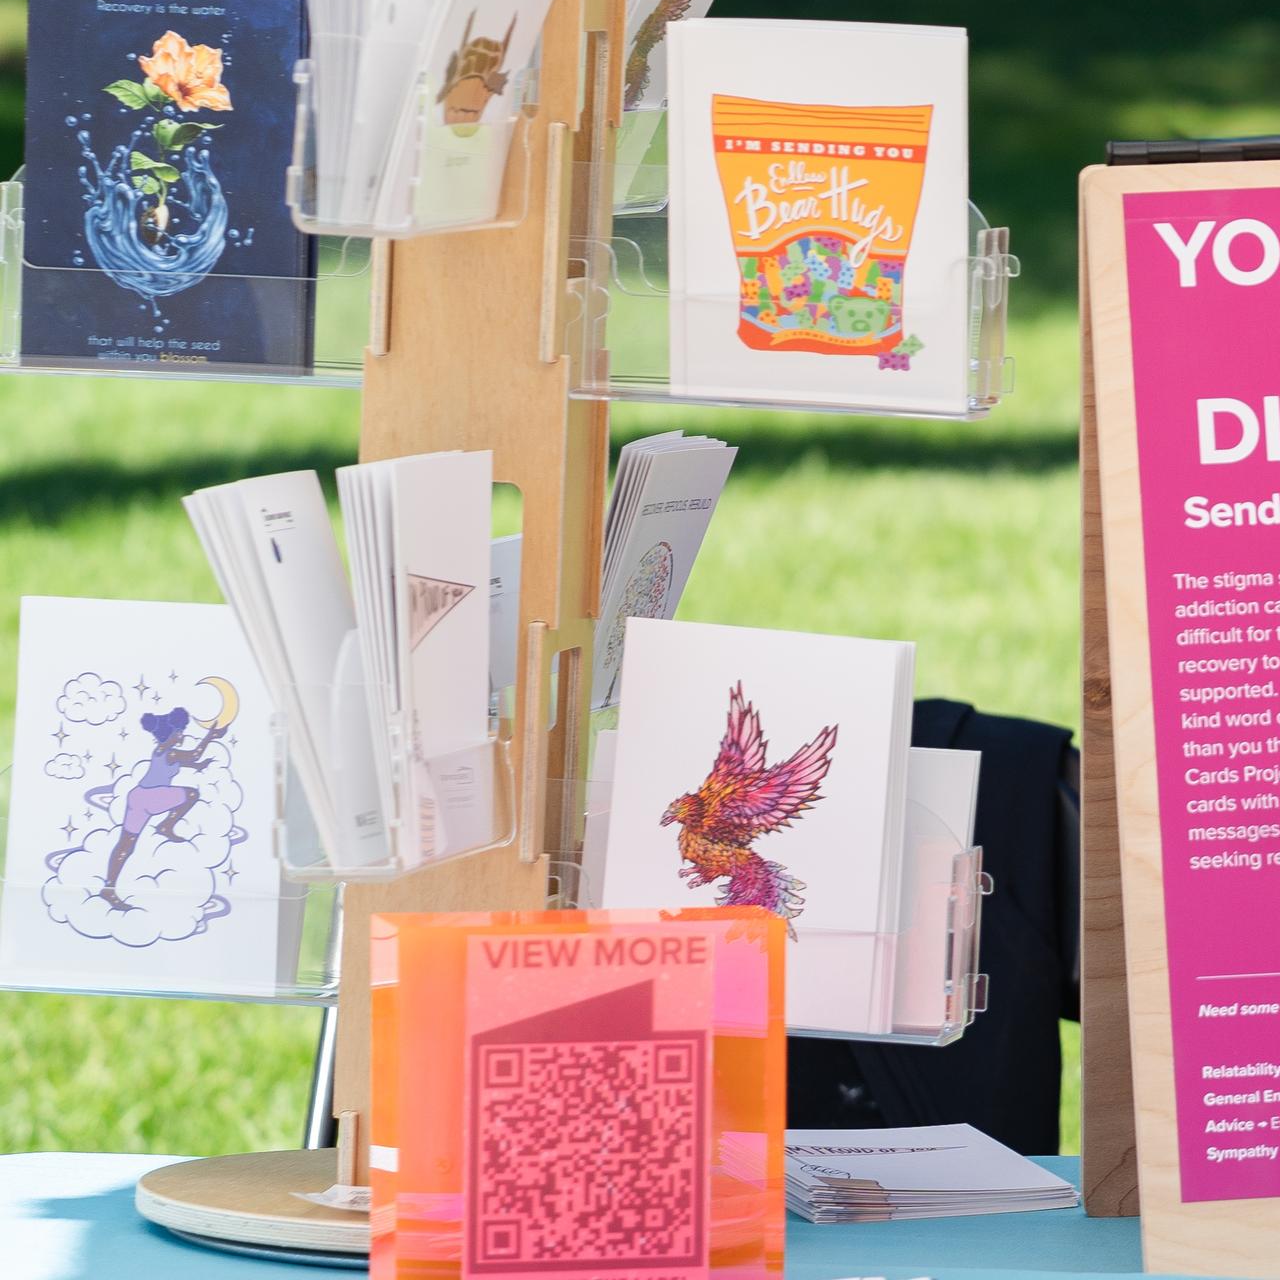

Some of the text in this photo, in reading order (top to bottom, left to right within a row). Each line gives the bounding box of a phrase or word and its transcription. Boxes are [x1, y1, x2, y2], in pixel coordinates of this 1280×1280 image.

[97, 0, 226, 15] Recovery is the water
[725, 138, 914, 159] I'M SENDING YOU
[734, 166, 904, 267] Bear Hugs
[88, 335, 221, 351] that will help the seed
[135, 352, 157, 363] you
[1172, 572, 1209, 590] The
[1213, 571, 1274, 591] stigma
[1174, 599, 1260, 618] addiction
[1176, 626, 1243, 646] difficult
[1246, 625, 1272, 642] for
[1178, 657, 1258, 674] recovery
[1261, 654, 1280, 670] to
[1179, 680, 1278, 704] supported.
[1181, 711, 1221, 729] kind
[1224, 709, 1272, 727] word
[1182, 740, 1224, 758] than
[1227, 741, 1262, 759] you
[1184, 766, 1240, 786] Cards
[1186, 794, 1237, 814] cards
[1240, 792, 1280, 810] with
[1188, 823, 1280, 842] messages
[1189, 850, 1262, 870] seeking
[481, 934, 708, 971] VIEW MORE
[1198, 1002, 1238, 1017] Need
[1239, 1003, 1280, 1015] some
[1203, 1090, 1261, 1106] General
